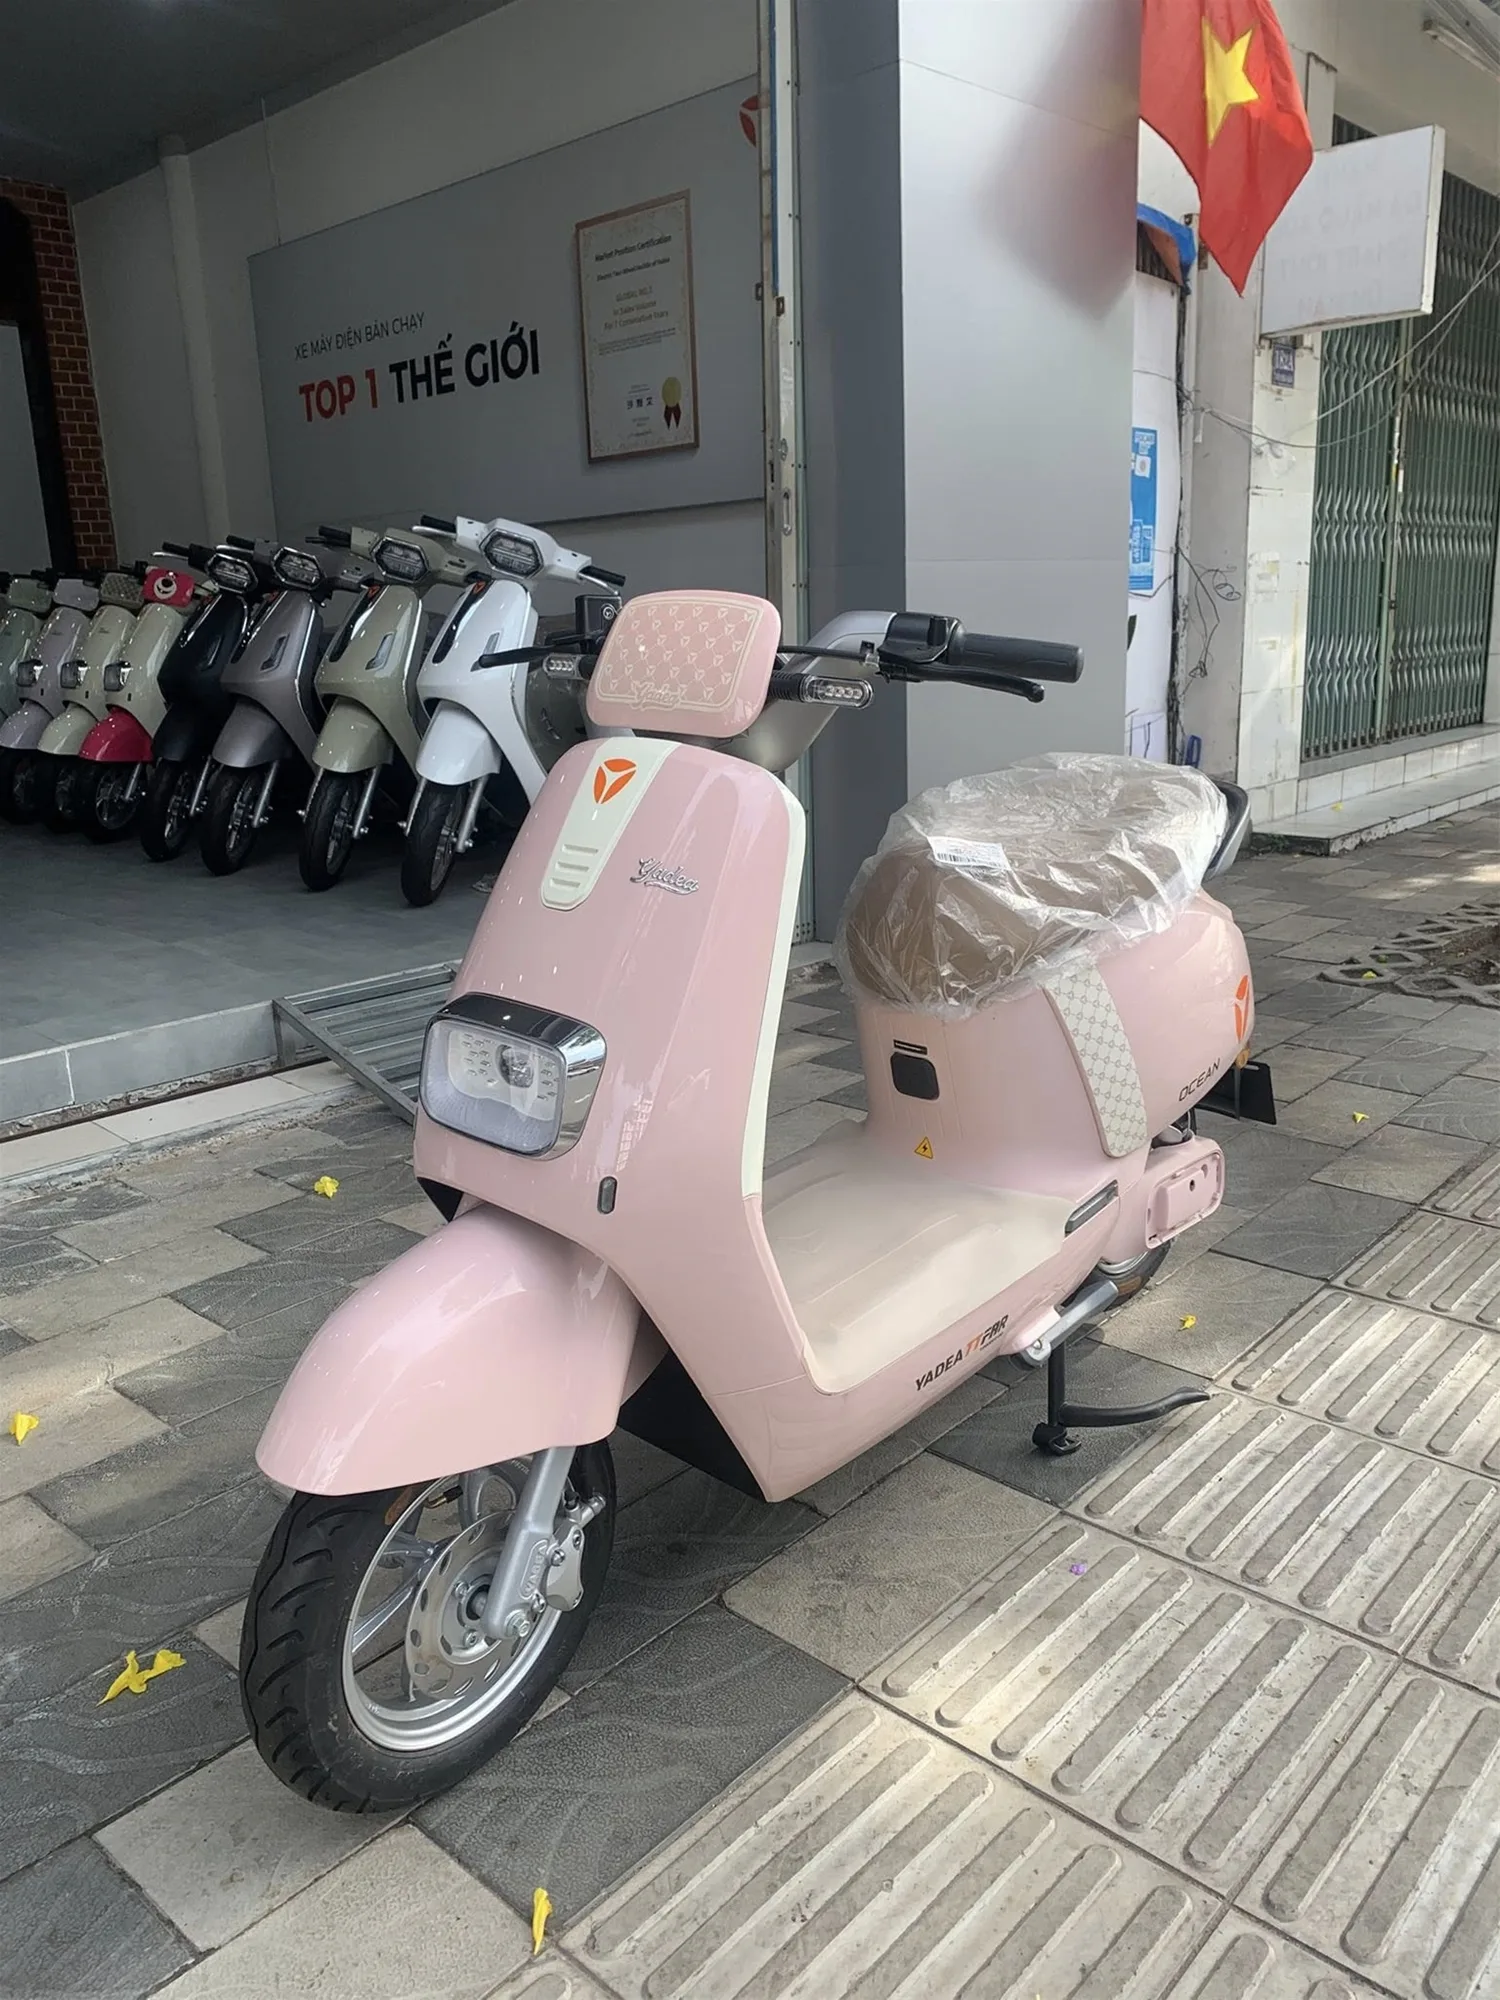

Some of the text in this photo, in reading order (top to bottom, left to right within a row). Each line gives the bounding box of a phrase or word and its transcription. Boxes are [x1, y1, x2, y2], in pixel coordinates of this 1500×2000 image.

[637, 235, 671, 251] Certification
[294, 311, 425, 361] XE MÁY ĐIỆN BÁN CHẠY
[298, 374, 356, 423] TOP
[364, 368, 379, 409] 1
[388, 333, 456, 404] THẾ
[464, 321, 540, 388] GIỚI
[629, 681, 681, 711] Yadea
[629, 857, 699, 894] Yadea
[1178, 1057, 1221, 1101] OCEAN
[915, 1349, 963, 1391] YADEA
